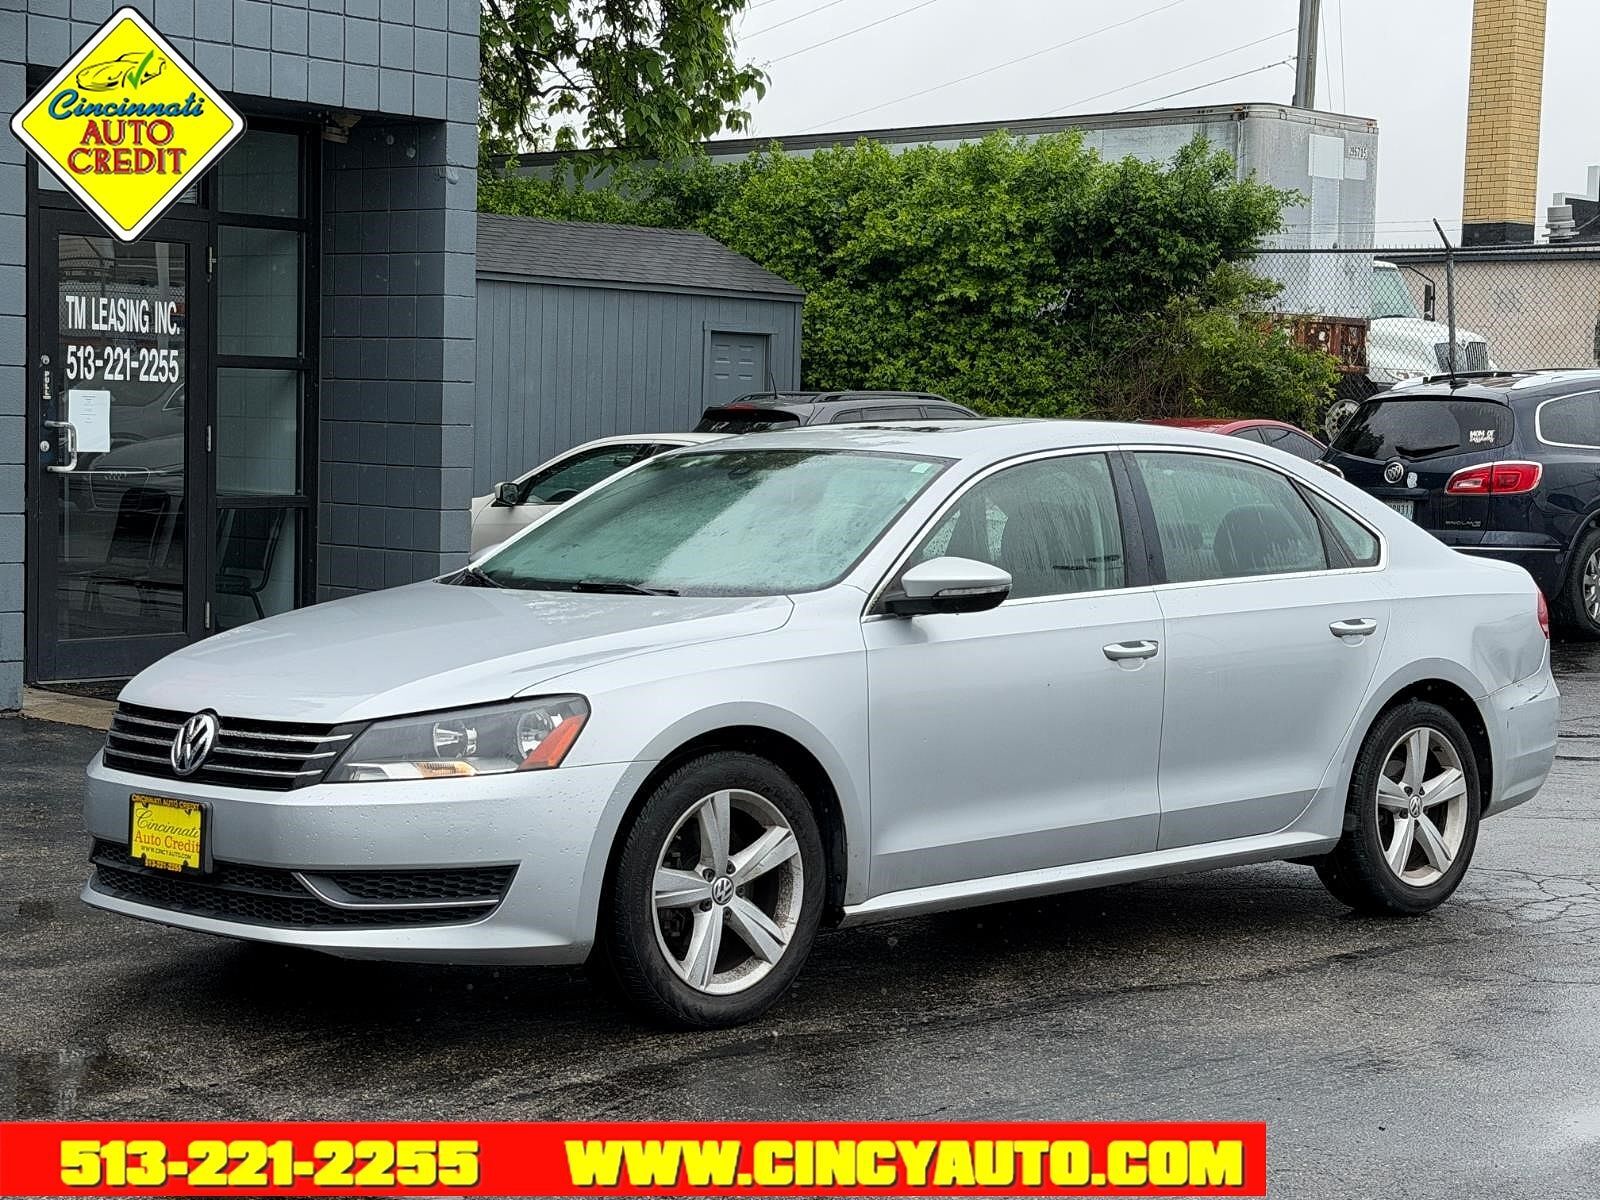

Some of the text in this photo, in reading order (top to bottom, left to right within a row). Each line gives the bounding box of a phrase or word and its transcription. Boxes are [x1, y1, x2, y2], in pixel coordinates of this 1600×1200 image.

[66, 295, 180, 335] TM LEASING INC.
[66, 345, 179, 383] 513-221-2255
[163, 798, 178, 808] AUTO
[134, 830, 200, 854] Auto Credit
